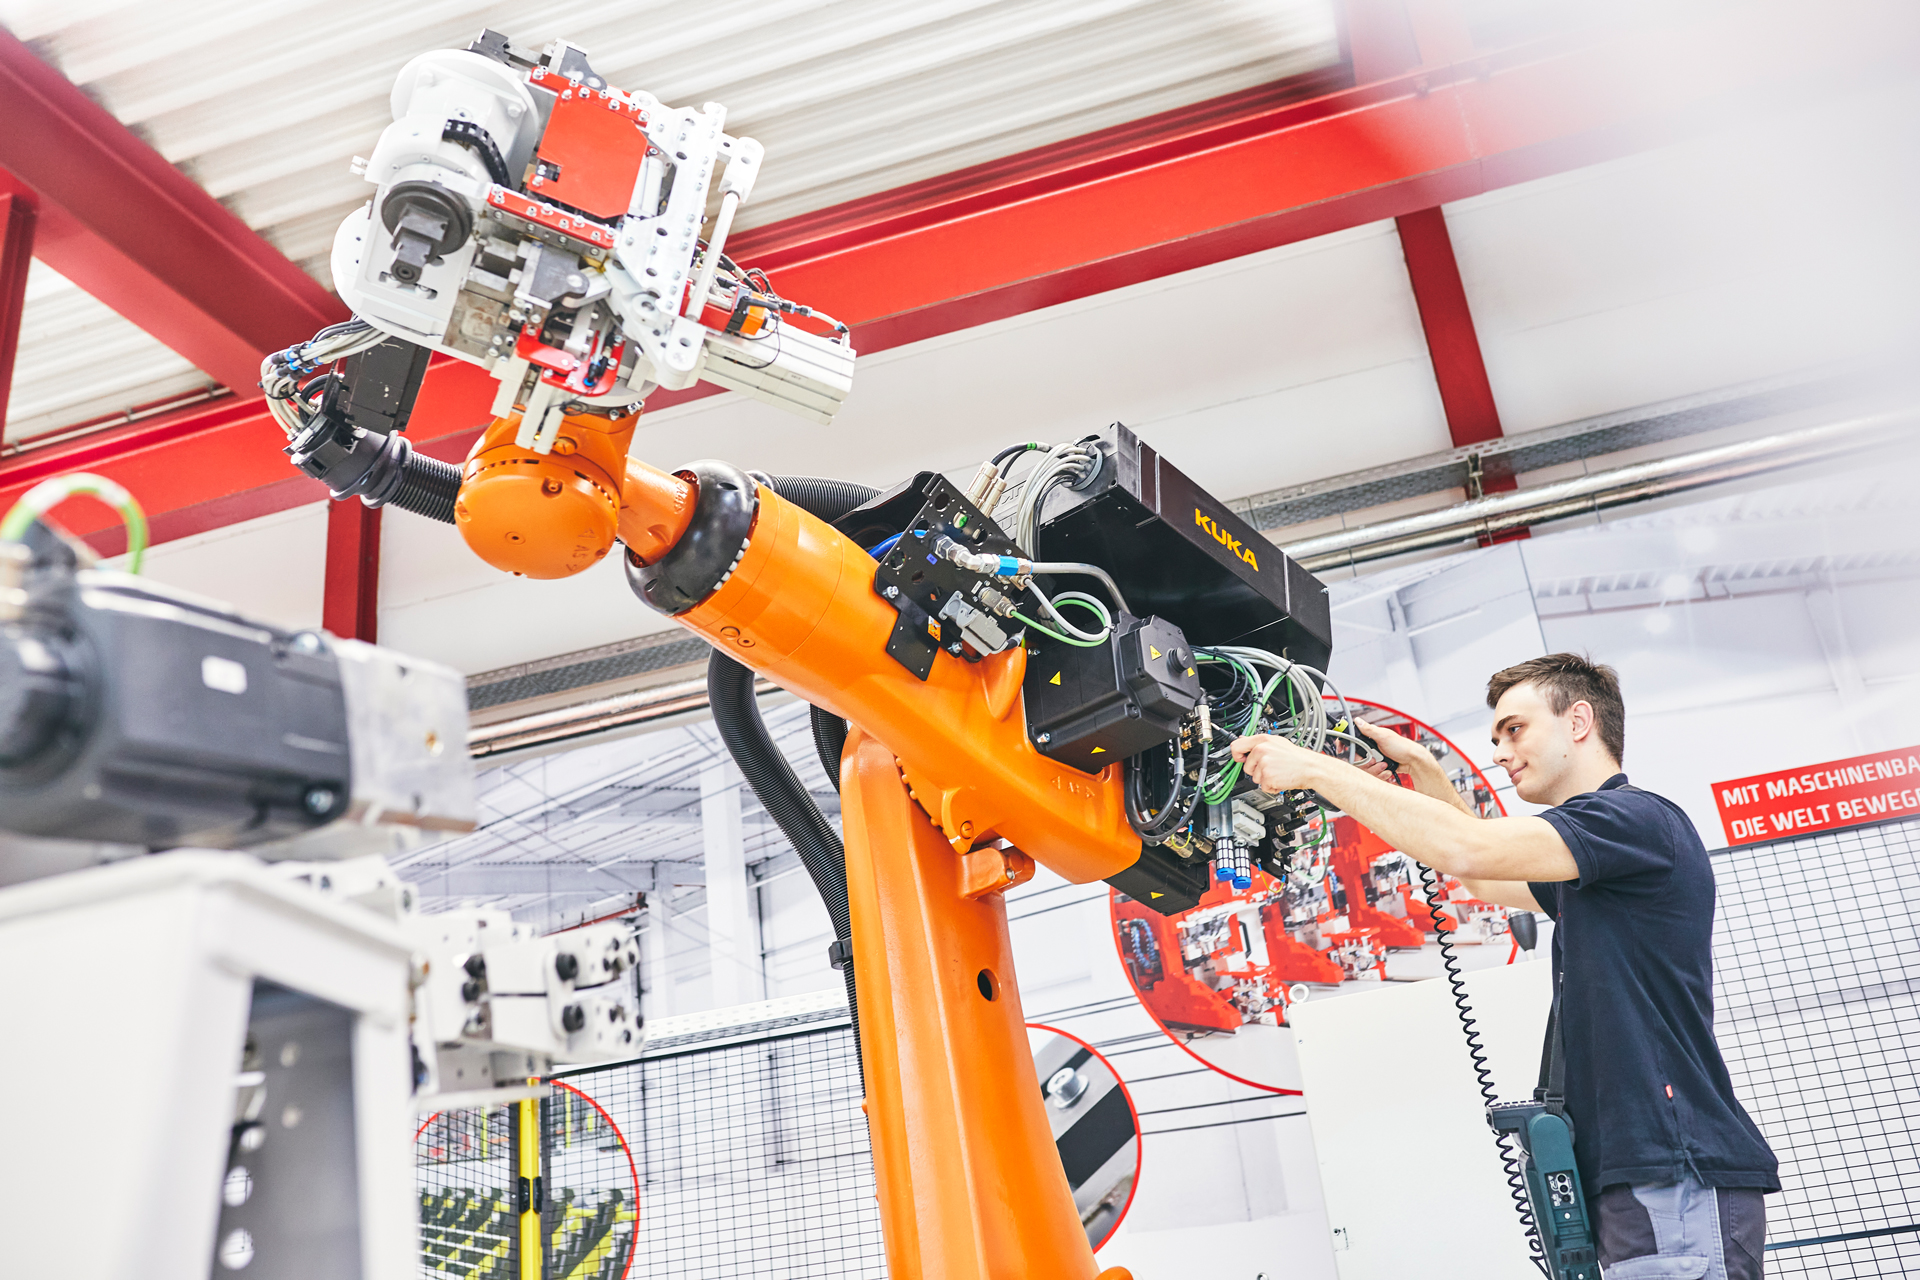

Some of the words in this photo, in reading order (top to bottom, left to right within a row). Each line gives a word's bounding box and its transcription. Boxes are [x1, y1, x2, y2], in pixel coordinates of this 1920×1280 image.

[1195, 508, 1259, 572] KUKA
[1721, 783, 1760, 808] MIT
[1765, 755, 1920, 800] MASCHINENBA
[1731, 815, 1768, 839] DIE
[1769, 804, 1831, 832] WELT
